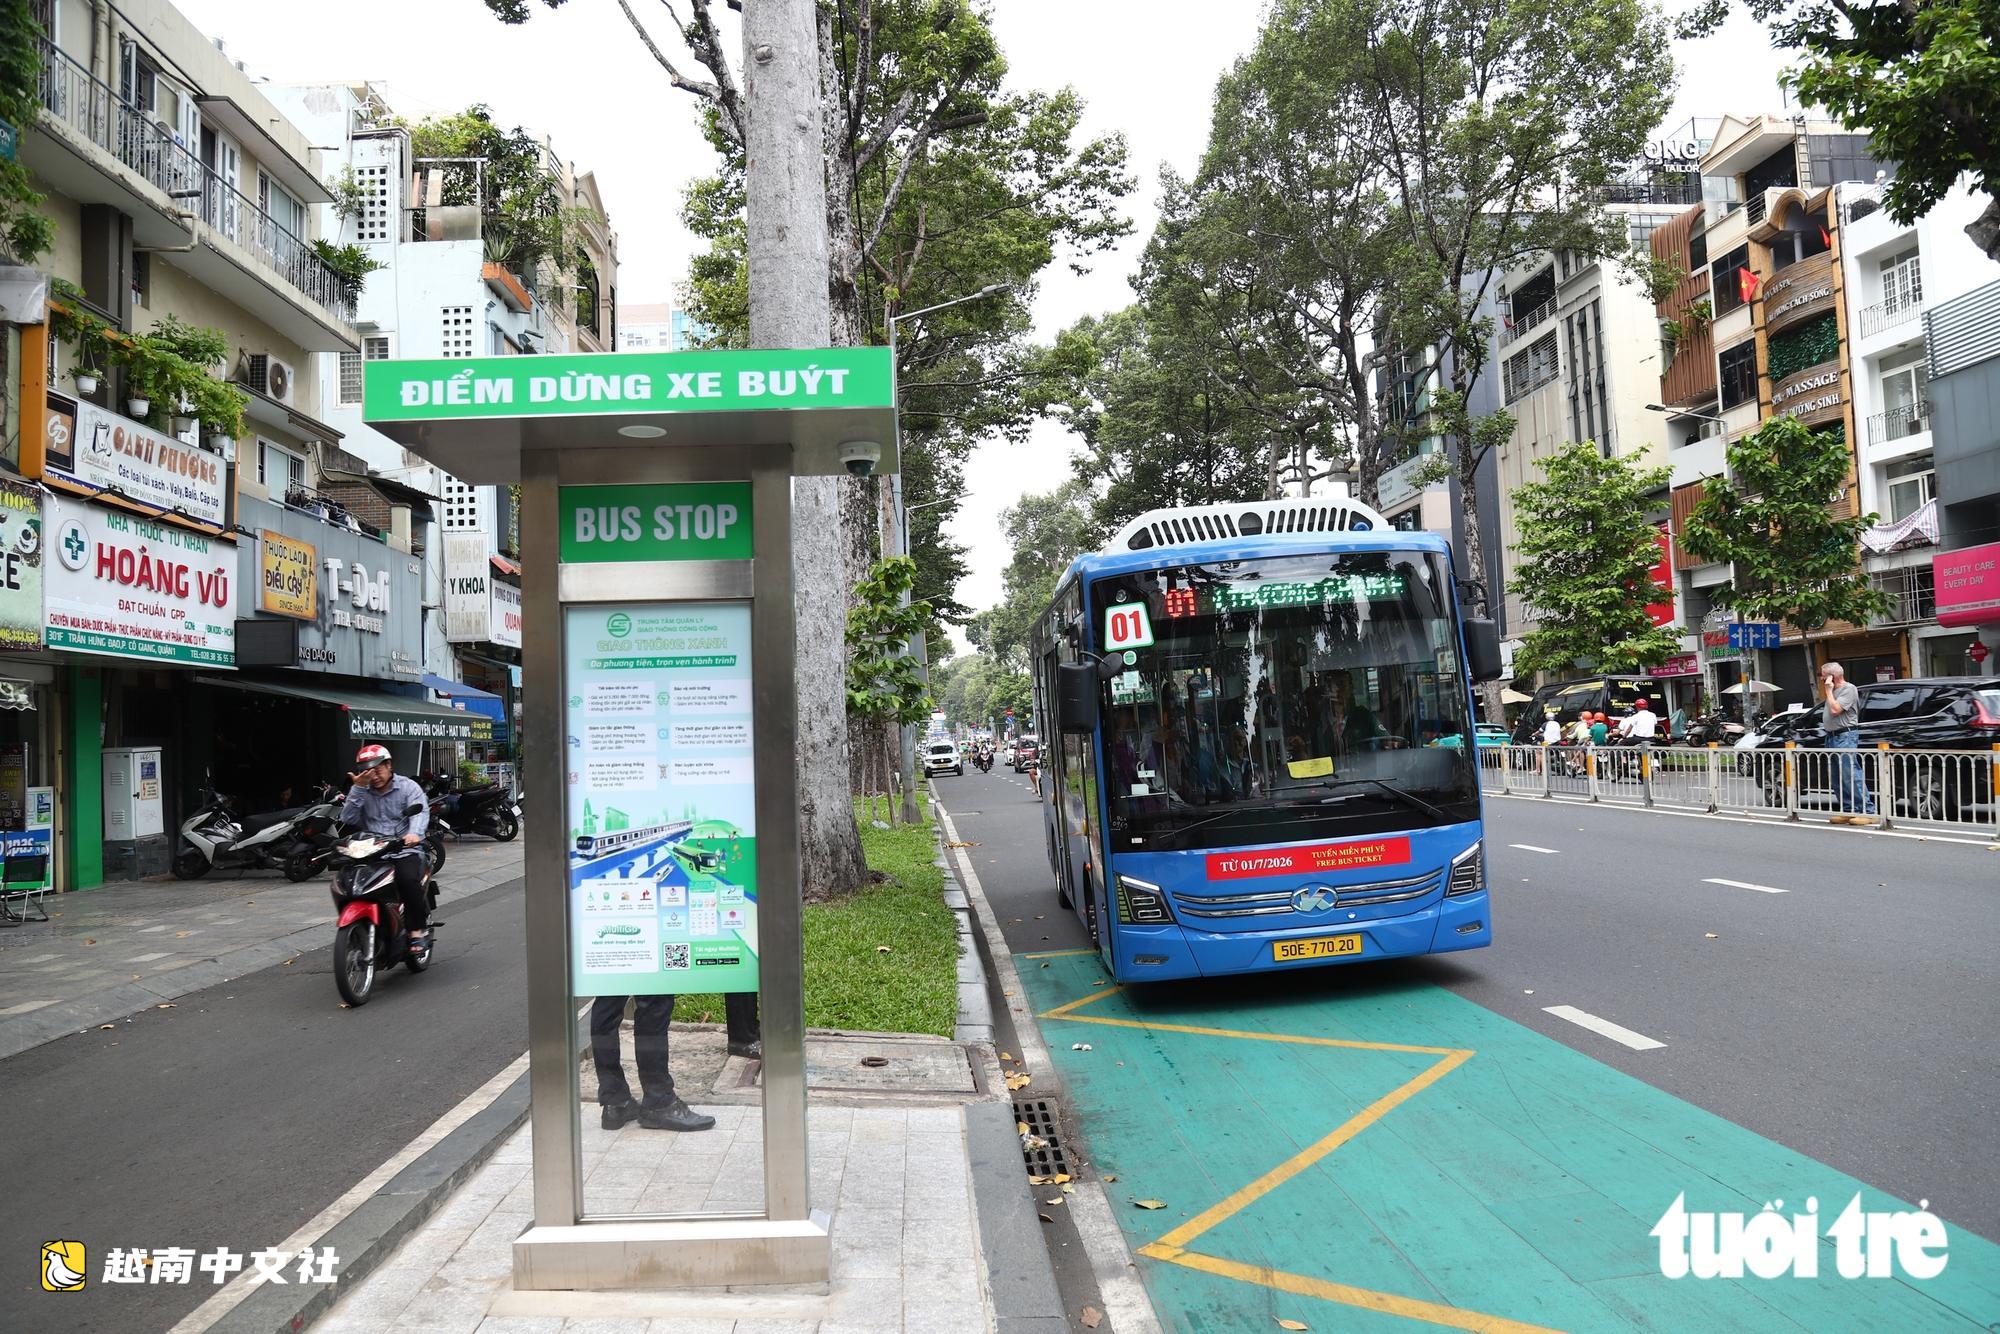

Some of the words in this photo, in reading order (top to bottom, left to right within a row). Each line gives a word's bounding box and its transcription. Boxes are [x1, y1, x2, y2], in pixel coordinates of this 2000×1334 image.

[1664, 164, 1700, 173] TAILOR
[1810, 287, 1830, 301] SỐNG
[400, 369, 513, 407] ĐIỂM
[529, 371, 651, 403] DỪNG
[666, 371, 723, 399] XE
[737, 364, 850, 397] BUÝT
[1786, 371, 1839, 398] MASSAGE
[1817, 393, 1839, 409] SINH
[118, 464, 129, 479] Các
[151, 478, 165, 491] xách
[575, 505, 642, 543] BUS
[648, 503, 738, 541] STOP
[107, 512, 129, 533] NHÀ
[134, 518, 164, 544] THUỐC
[169, 530, 180, 547] TƯ
[184, 533, 208, 554] NHÂN
[265, 539, 287, 559] THUỐC
[289, 546, 303, 564] LÀO
[96, 542, 189, 599] HOÀNG
[197, 567, 228, 608] VŨ
[1943, 565, 1972, 576] BEAUTY
[1975, 560, 1996, 571] CARE
[265, 561, 285, 590] ĐIẾU
[287, 569, 303, 598] CÀY
[324, 558, 390, 614] T-Deli
[450, 578, 456, 595] Y
[459, 577, 485, 595] KHOA
[1944, 578, 1967, 589] EVERY
[1969, 576, 1984, 585] DAY
[118, 599, 137, 613] ĐẠT
[137, 600, 166, 618] CHUẨN
[171, 608, 185, 621] GPP
[279, 600, 293, 610] SINCE
[1165, 588, 1195, 617] 01
[50, 613, 69, 626] CHUYÊN
[70, 617, 80, 628] MUA
[1111, 611, 1143, 642] 01
[48, 630, 64, 641] 301F
[68, 631, 86, 644] TRẦN
[88, 635, 106, 646] HƯNG
[596, 638, 632, 652] GIAO
[635, 636, 685, 651] THÔNG
[687, 637, 728, 649] XANH
[602, 658, 634, 669] phương
[635, 658, 654, 668] tiện,
[656, 658, 673, 667] trọn
[675, 658, 690, 667] vẹn
[692, 656, 712, 665] hành
[714, 656, 736, 665] trình
[351, 716, 361, 734] CÀ
[363, 717, 376, 735] PHÊ
[377, 720, 390, 736] PHA
[391, 719, 404, 735] MÁY
[408, 720, 431, 736] NGUYÊN
[432, 719, 446, 737] CHẤT
[459, 725, 471, 738] 100%
[1312, 849, 1337, 859] TUYẾN
[1339, 846, 1359, 857] MIỄN
[1361, 844, 1374, 854] PHÍ
[1220, 858, 1239, 872] TỪ
[1241, 856, 1293, 870] 01/7/2026
[1316, 859, 1337, 867] FREE
[1338, 858, 1353, 866] BUS
[1354, 855, 1383, 863] TICKET
[1281, 939, 1354, 958] 50E-770.20
